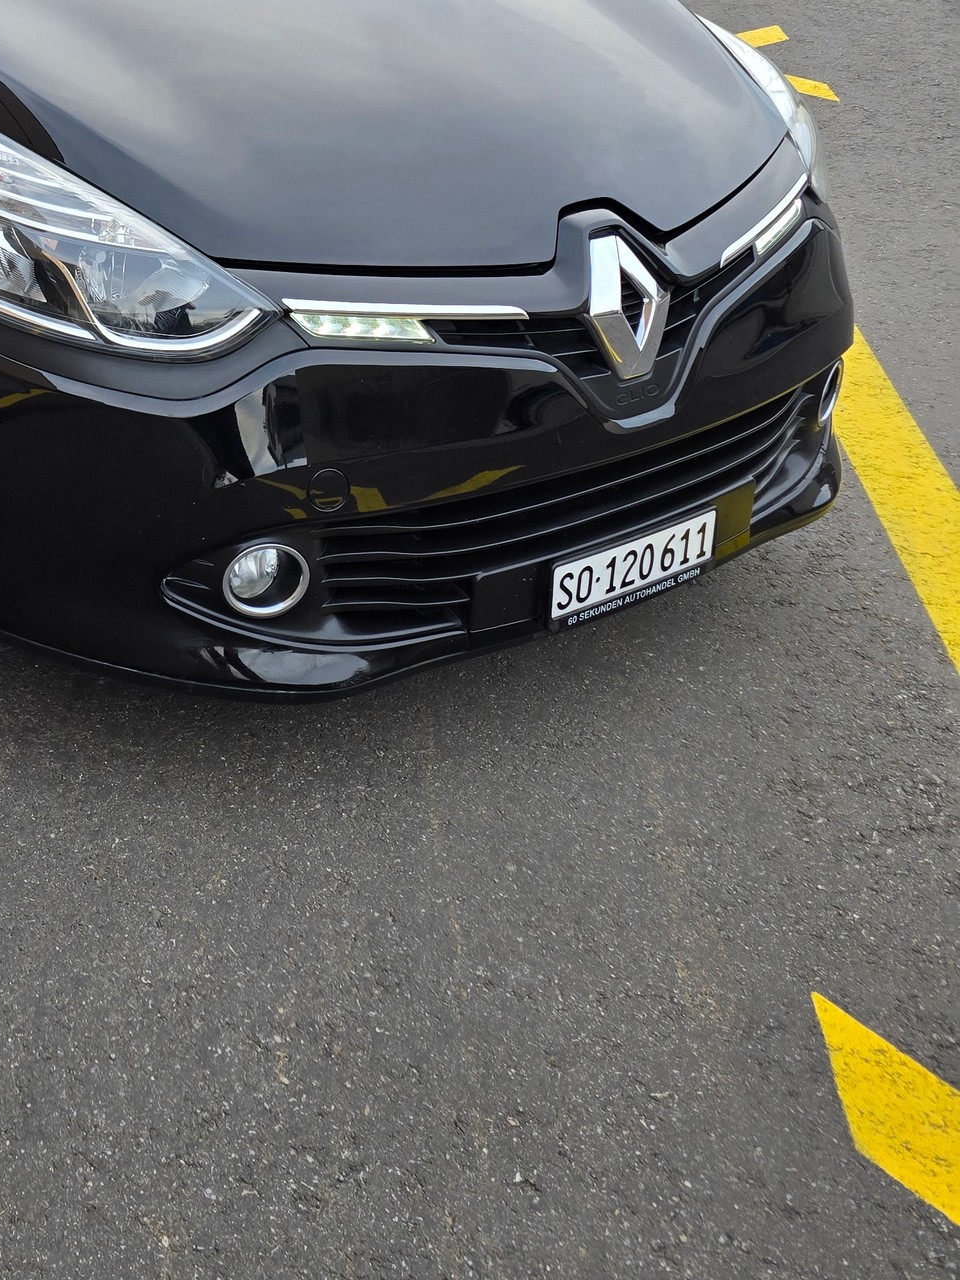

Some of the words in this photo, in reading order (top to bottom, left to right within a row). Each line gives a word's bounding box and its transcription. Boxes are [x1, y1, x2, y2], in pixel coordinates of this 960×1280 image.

[615, 384, 660, 406] CLIO
[567, 614, 578, 626] 60
[578, 598, 623, 622] SEKUNDEN
[624, 577, 677, 606] AUTOHANDEL
[677, 567, 701, 584] GMBH
